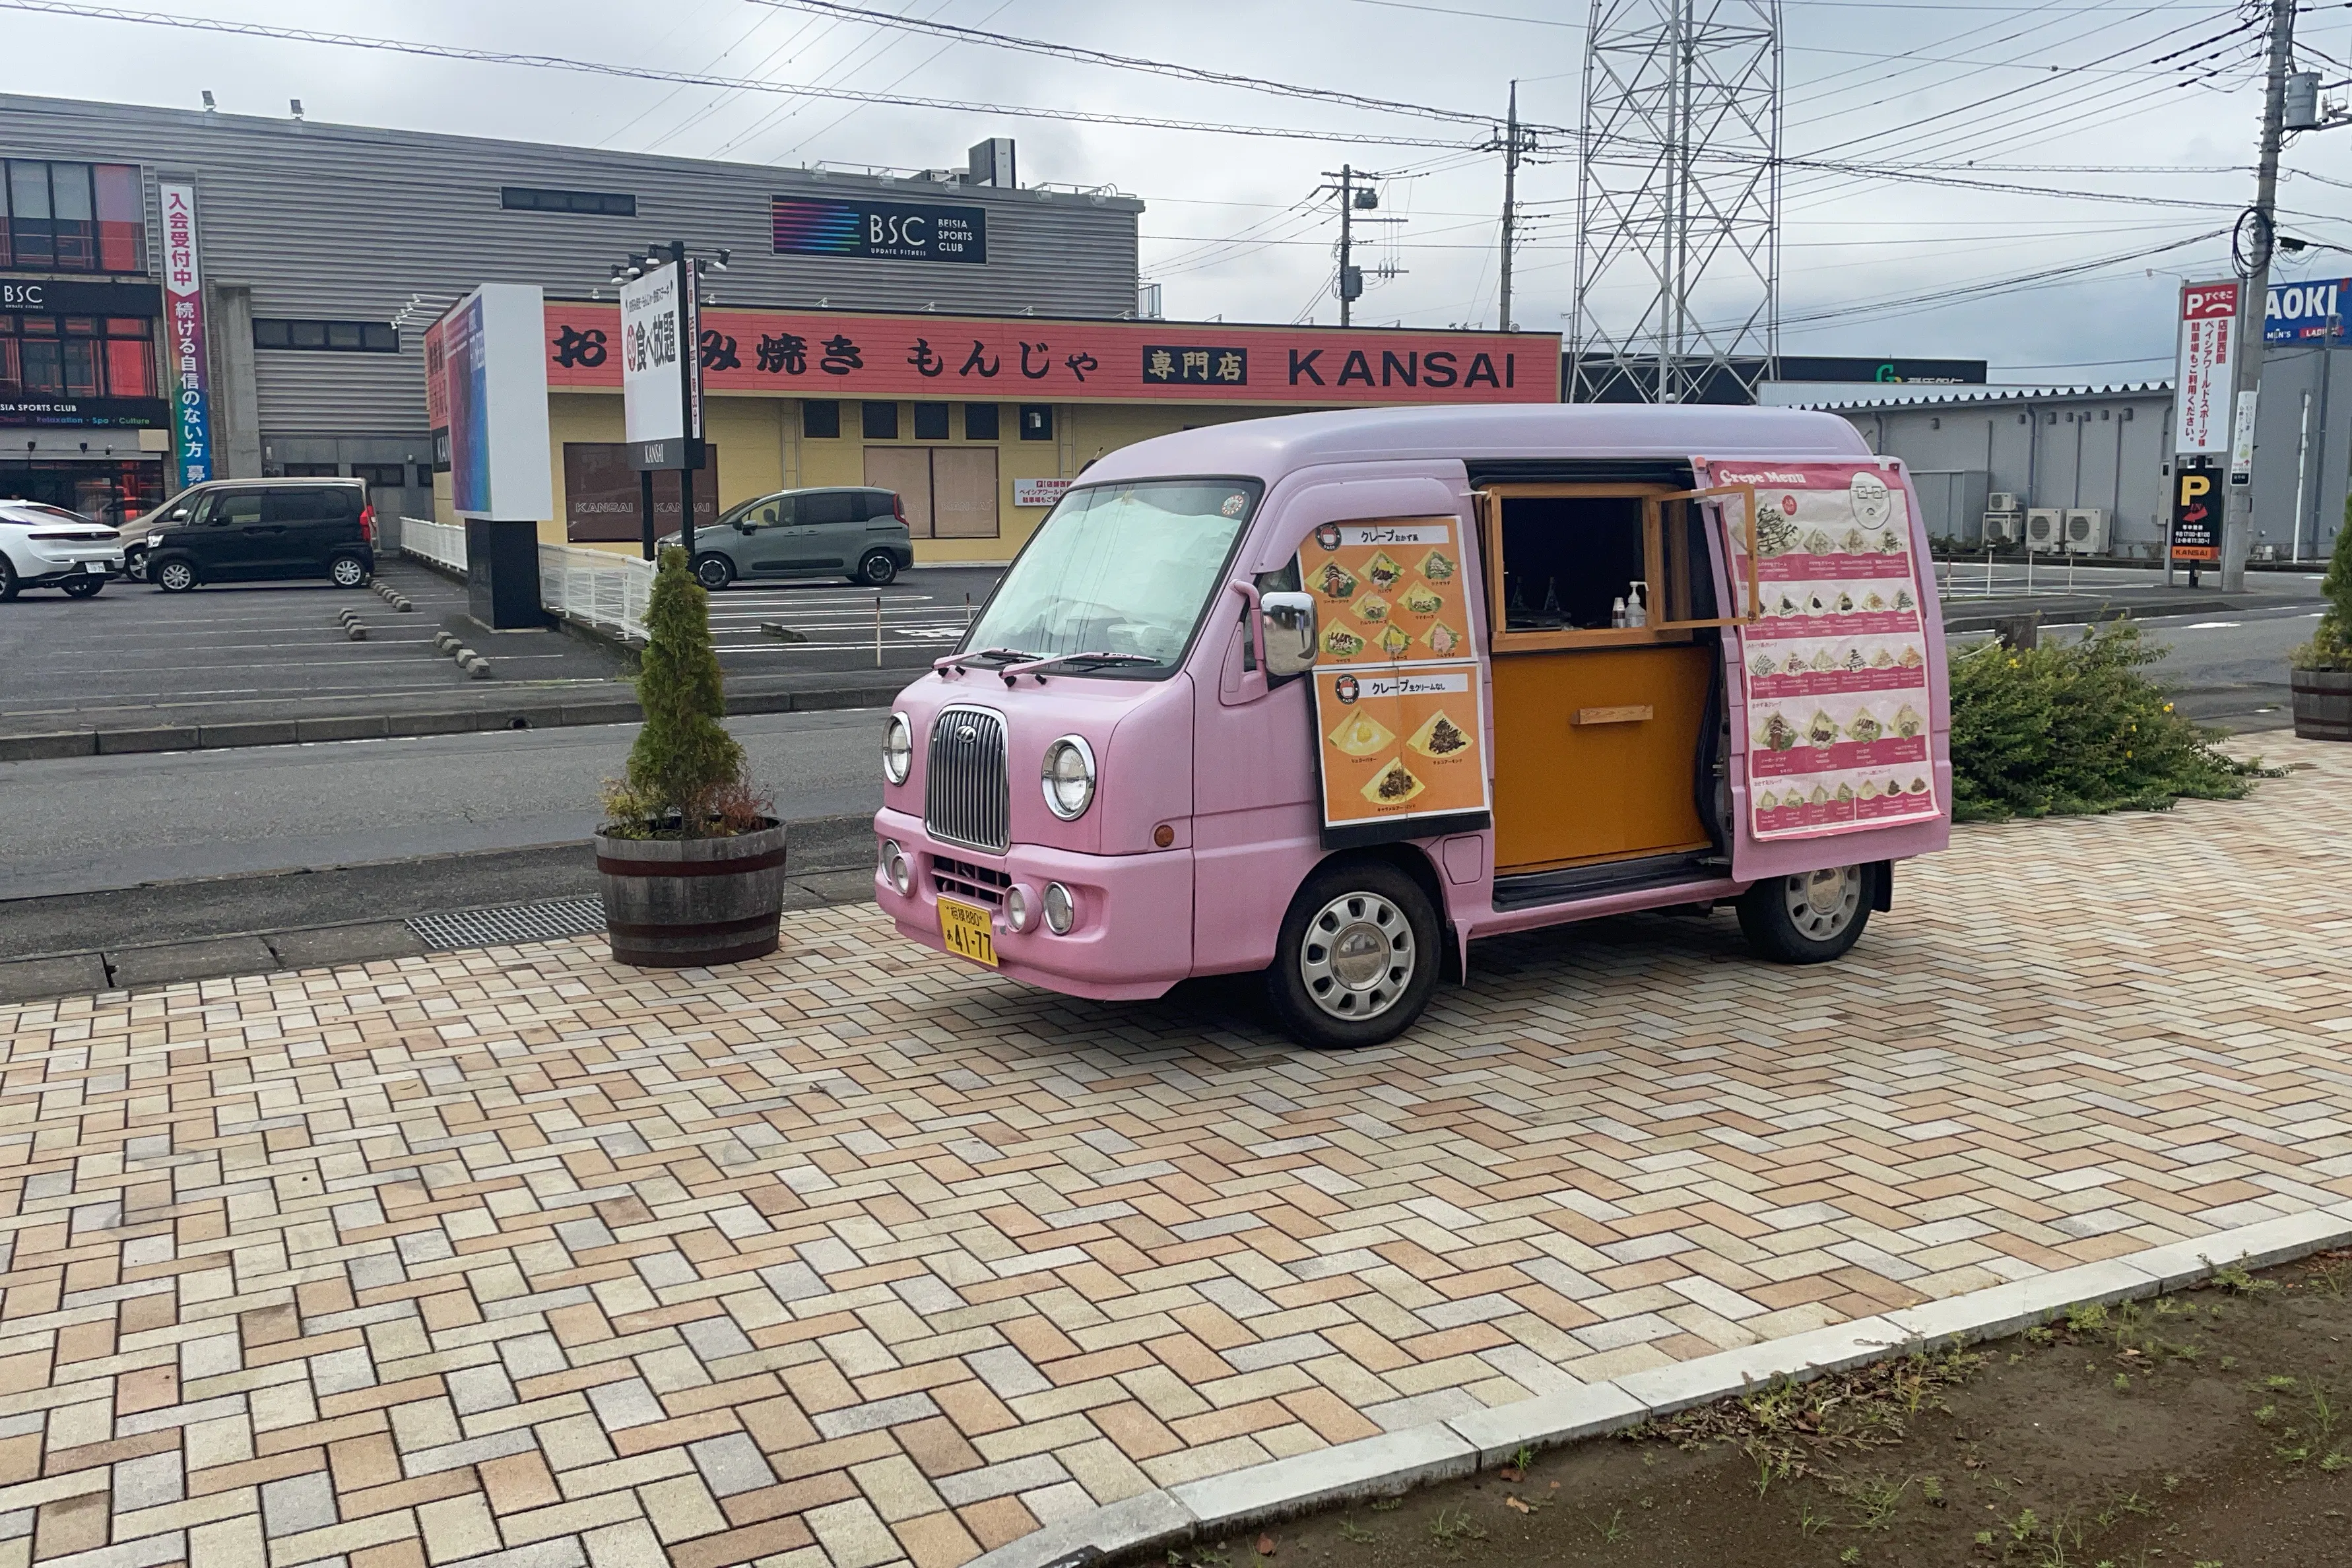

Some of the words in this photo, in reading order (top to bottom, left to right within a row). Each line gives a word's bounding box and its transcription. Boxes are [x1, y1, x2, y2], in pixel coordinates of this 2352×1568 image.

[870, 214, 925, 246] BSC
[938, 219, 967, 229] BEISIA
[168, 193, 192, 286] 入会受付中
[938, 231, 973, 241] SPORTS
[938, 242, 964, 252] CLUB
[4, 285, 43, 303] BSC
[2186, 294, 2204, 316] P
[2205, 291, 2233, 302] すぐそこ
[2265, 284, 2337, 320] AOKI
[636, 310, 676, 372] 食べ放題
[553, 325, 863, 376] おみ焼き
[907, 337, 1098, 382] もんじゃ
[1148, 349, 1242, 381] 専門店
[1289, 348, 1514, 388] KANSAI
[175, 301, 203, 458] 続ける自信のない方
[645, 443, 664, 463] KANSAI
[1720, 469, 1765, 485] Crepe
[1763, 471, 1806, 483] Menu
[2181, 475, 2211, 506] P
[575, 502, 633, 513] KANSAI
[1361, 529, 1395, 542] クレープ
[1372, 679, 1410, 695] クレープ
[1409, 682, 1446, 692] 生クリームなし
[947, 928, 954, 942] あ
[955, 924, 991, 962] 41-77
